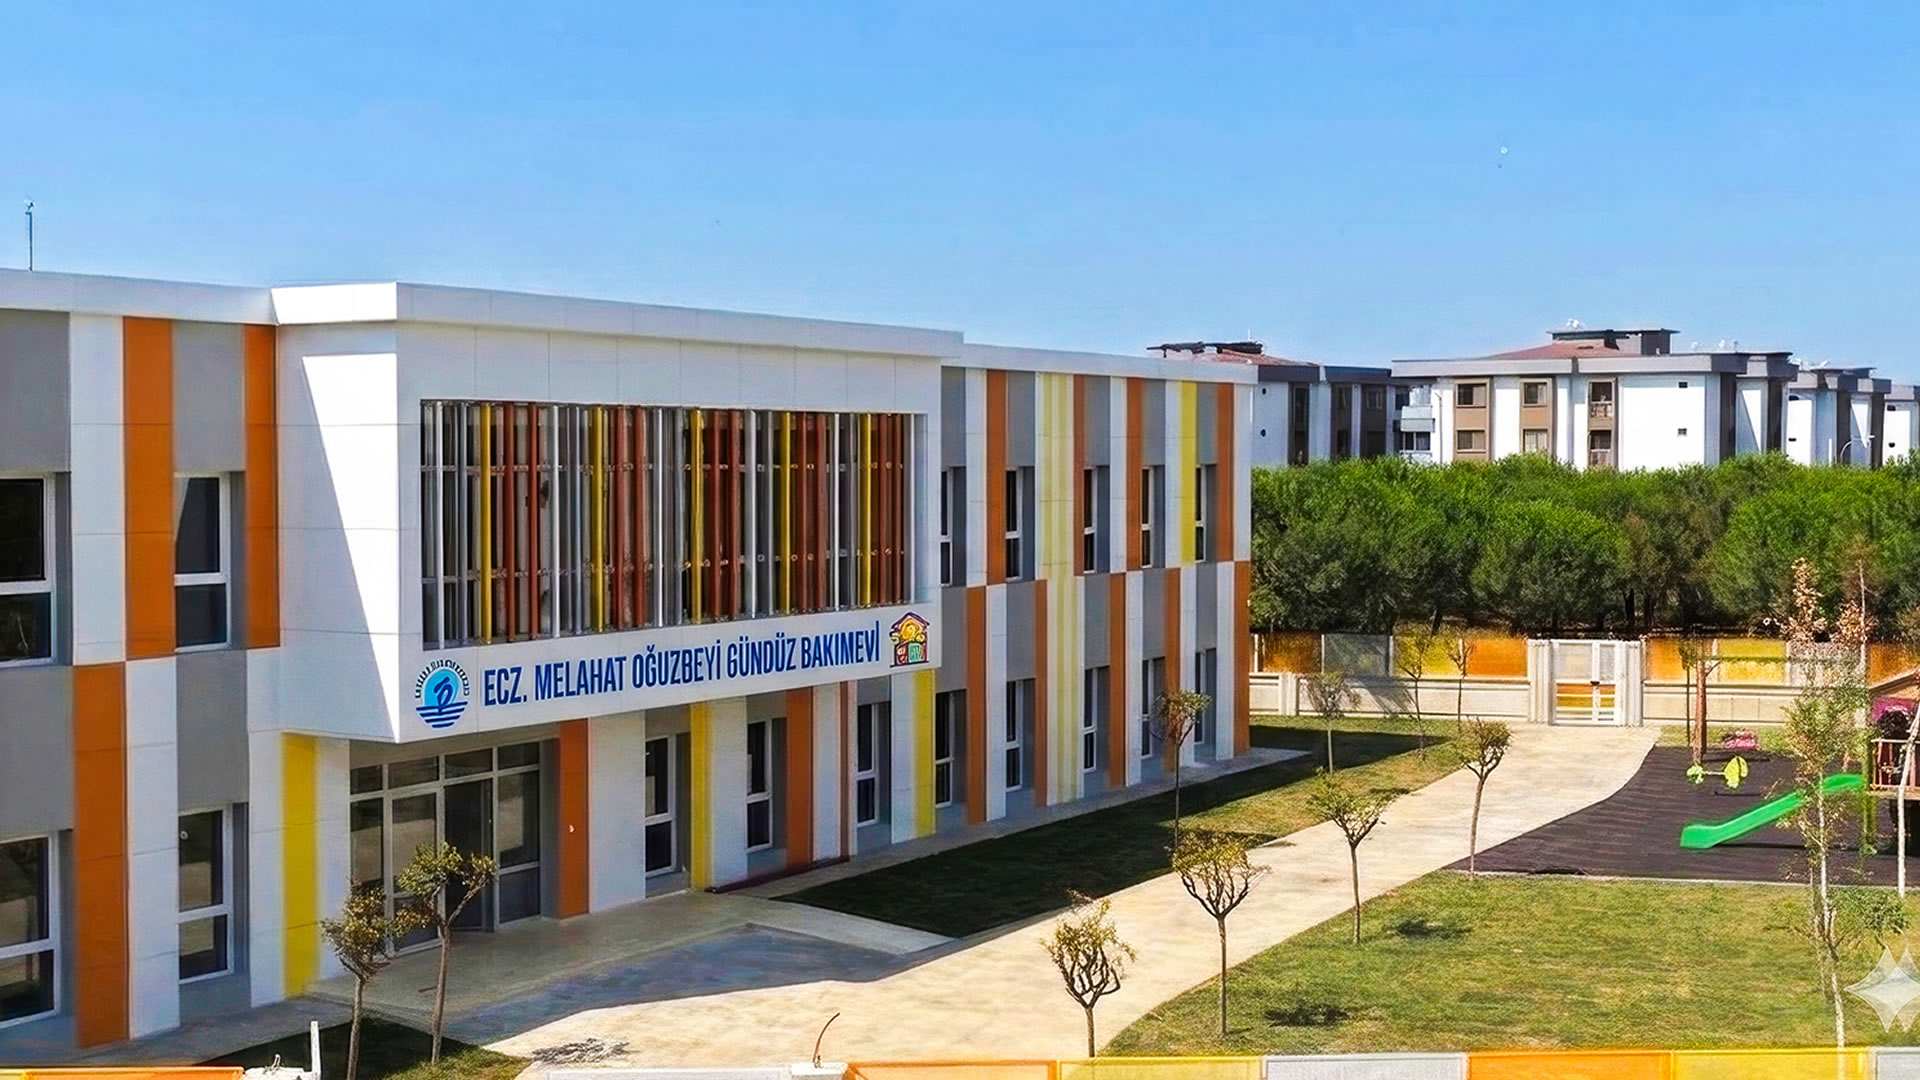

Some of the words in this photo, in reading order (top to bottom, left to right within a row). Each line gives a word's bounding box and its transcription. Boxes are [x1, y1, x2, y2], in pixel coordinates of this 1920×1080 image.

[484, 666, 527, 706] ECZ.
[535, 656, 626, 701] MELAHAT
[632, 639, 721, 688] OĞUZBEYİ
[727, 632, 796, 678] GÜNDÜZ
[801, 620, 880, 669] BAKIMEVİ
